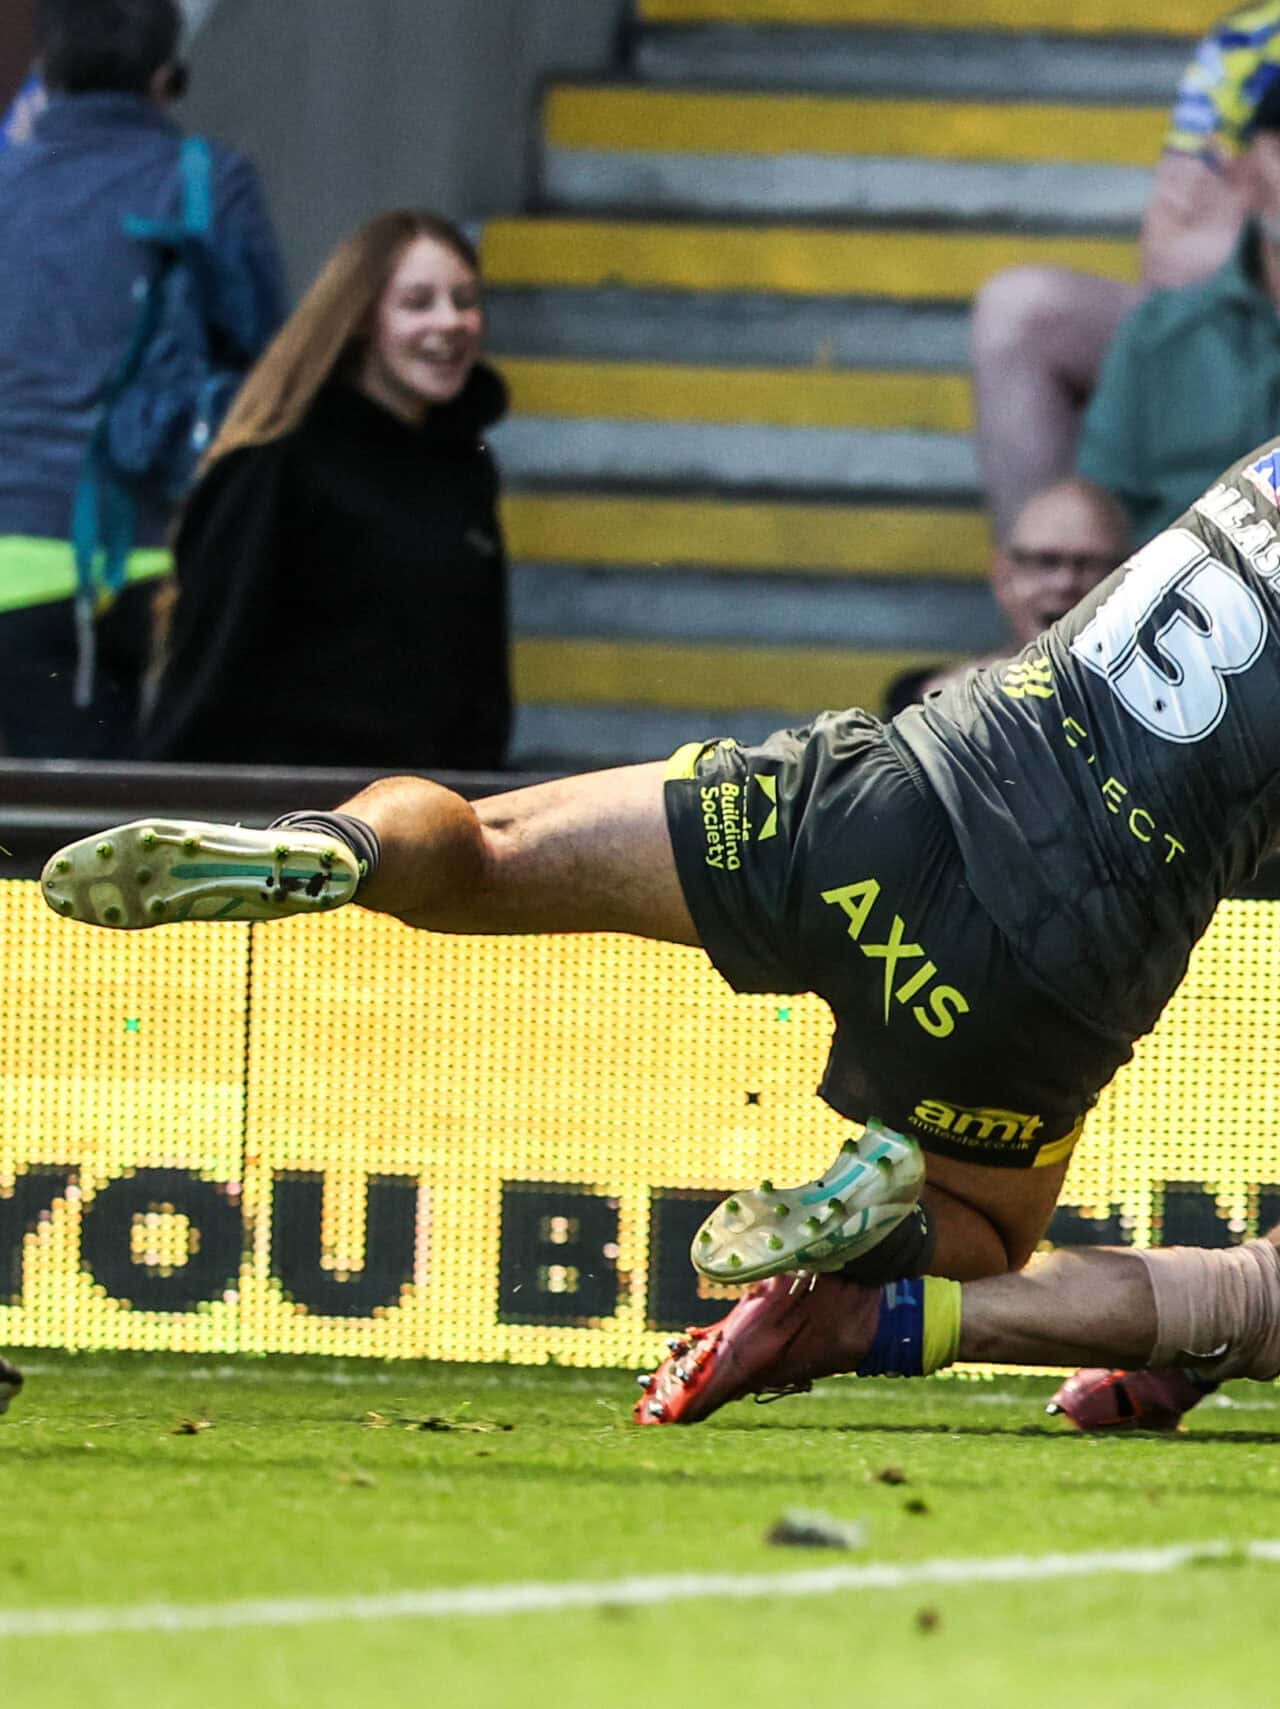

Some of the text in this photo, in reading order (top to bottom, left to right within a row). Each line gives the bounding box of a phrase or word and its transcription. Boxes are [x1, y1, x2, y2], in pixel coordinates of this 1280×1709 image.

[1068, 526, 1269, 745] 13
[700, 786, 725, 870] Society
[820, 877, 971, 1039] AXIS
[914, 1099, 1044, 1142] amt
